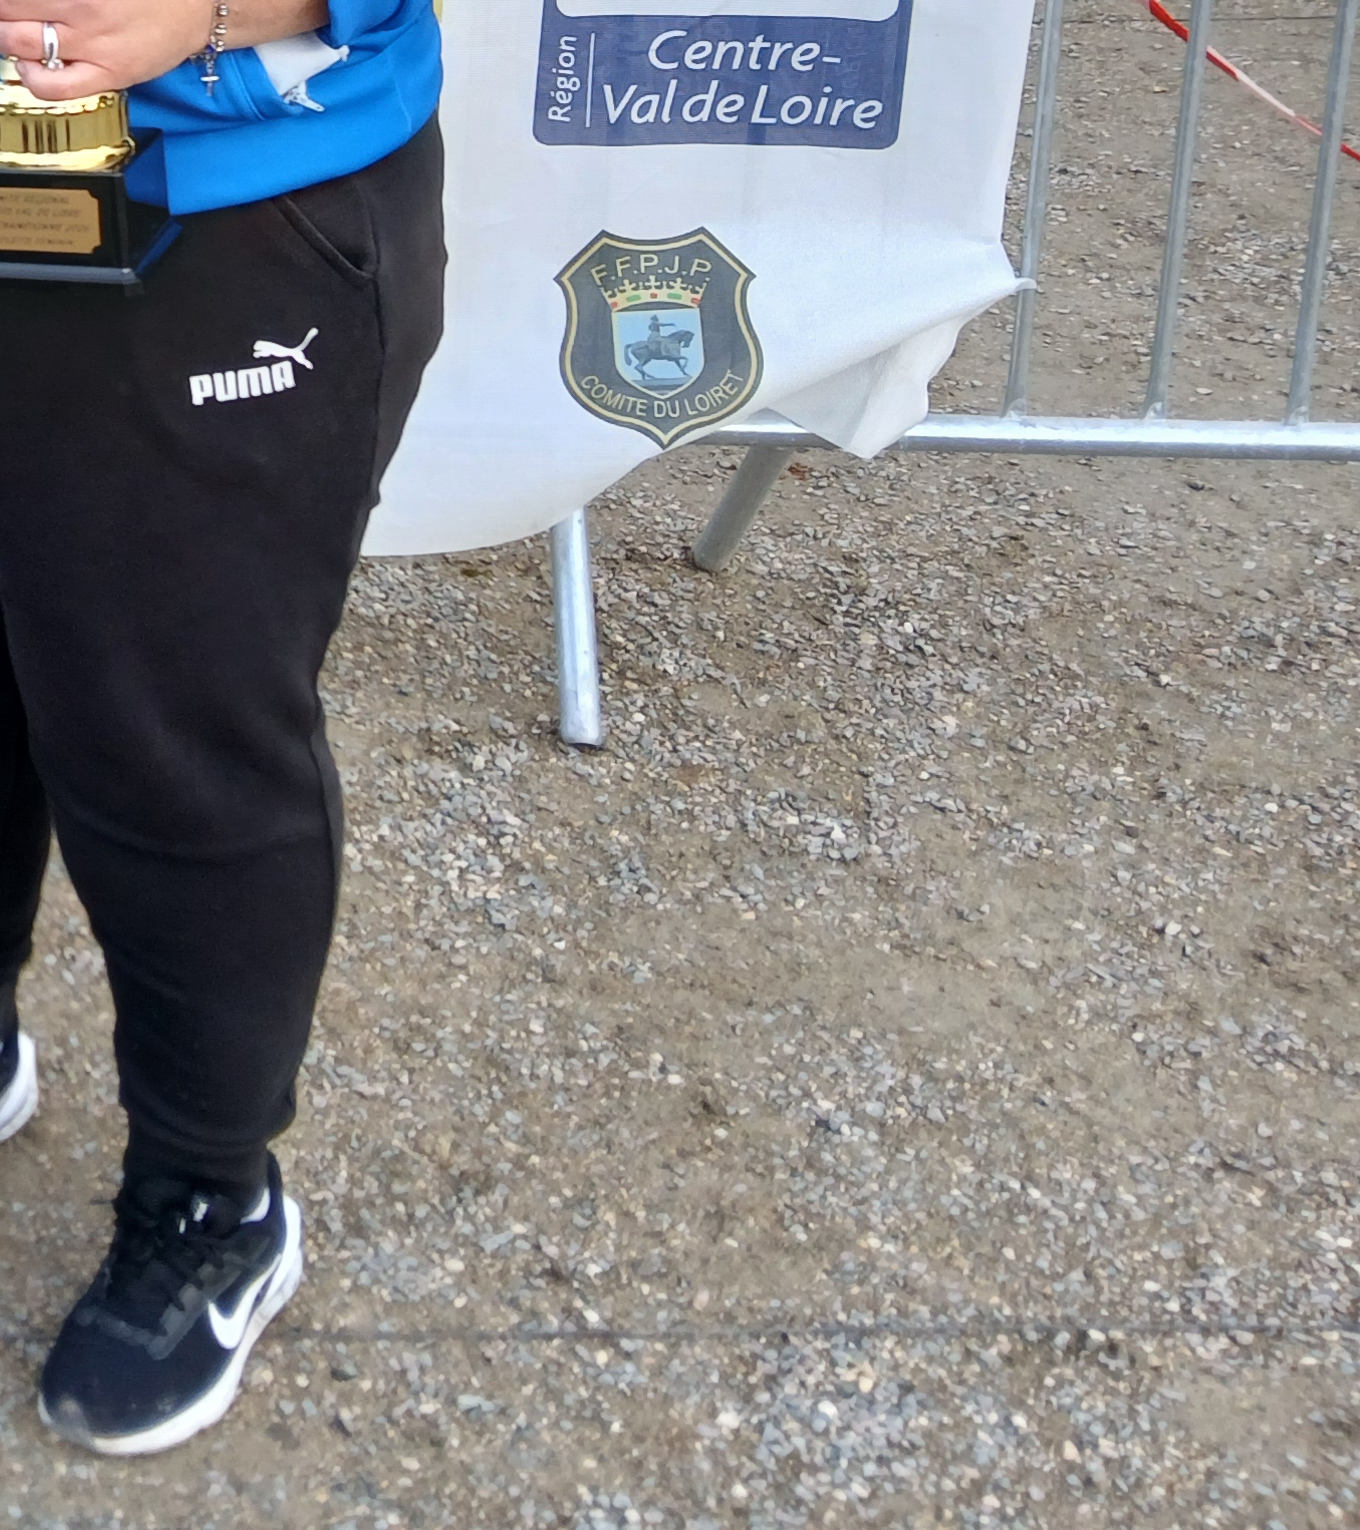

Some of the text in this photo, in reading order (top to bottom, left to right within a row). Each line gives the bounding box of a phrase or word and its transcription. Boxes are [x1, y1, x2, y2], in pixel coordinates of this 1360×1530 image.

[647, 30, 842, 71] Centre-
[548, 35, 579, 123] Région
[602, 79, 883, 129] Val de Loire
[188, 360, 297, 406] PUMA
[580, 369, 745, 418] COMITE DU LOIRET
